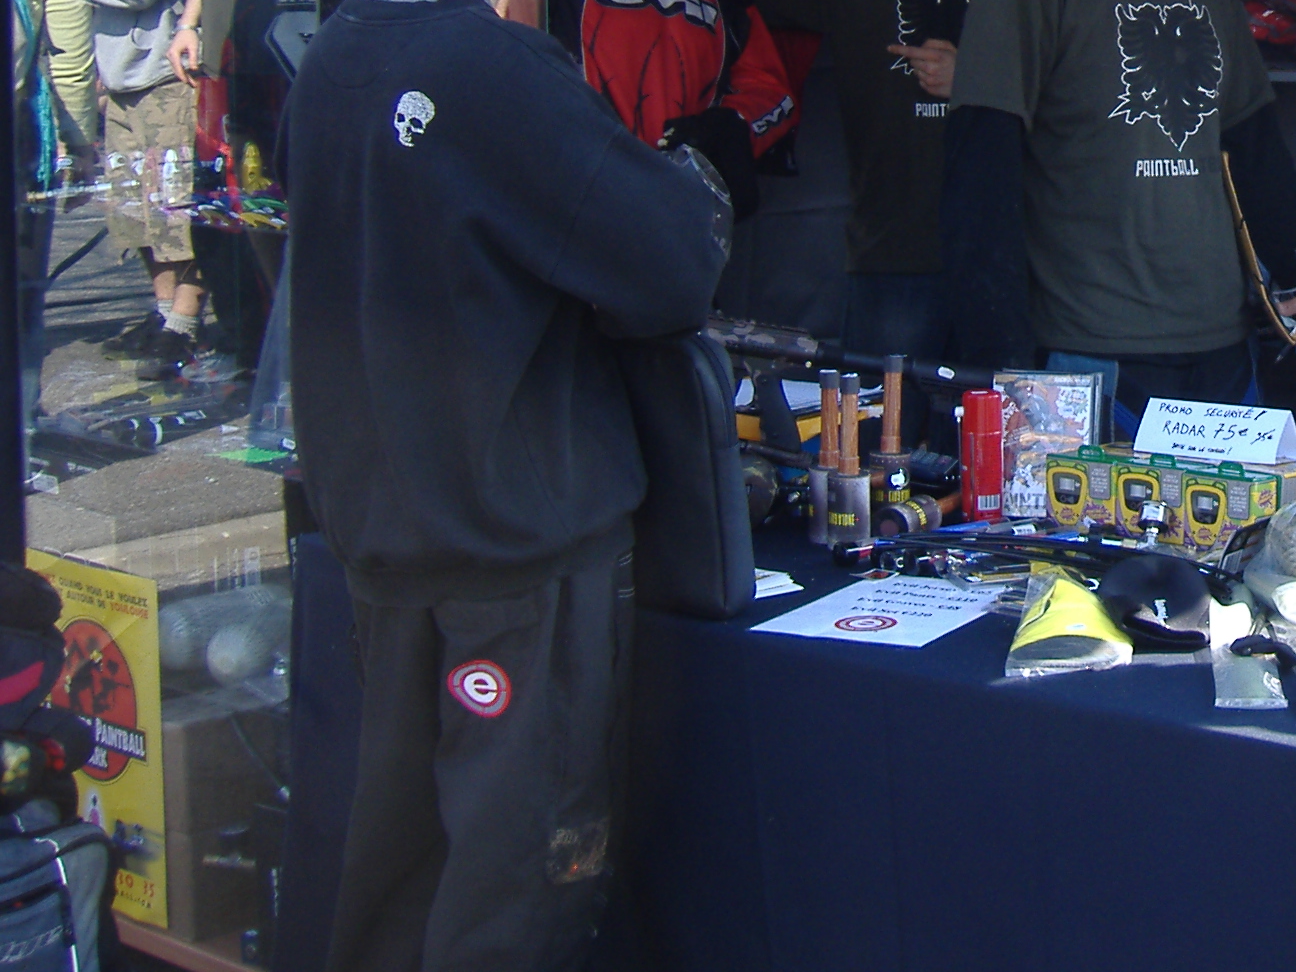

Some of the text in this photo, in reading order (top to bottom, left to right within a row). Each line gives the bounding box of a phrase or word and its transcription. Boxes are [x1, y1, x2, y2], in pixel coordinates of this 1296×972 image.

[915, 103, 950, 118] PAINT
[1162, 420, 1206, 438] RADAR
[95, 716, 145, 757] PAINTBALL
[87, 746, 109, 768] ARK
